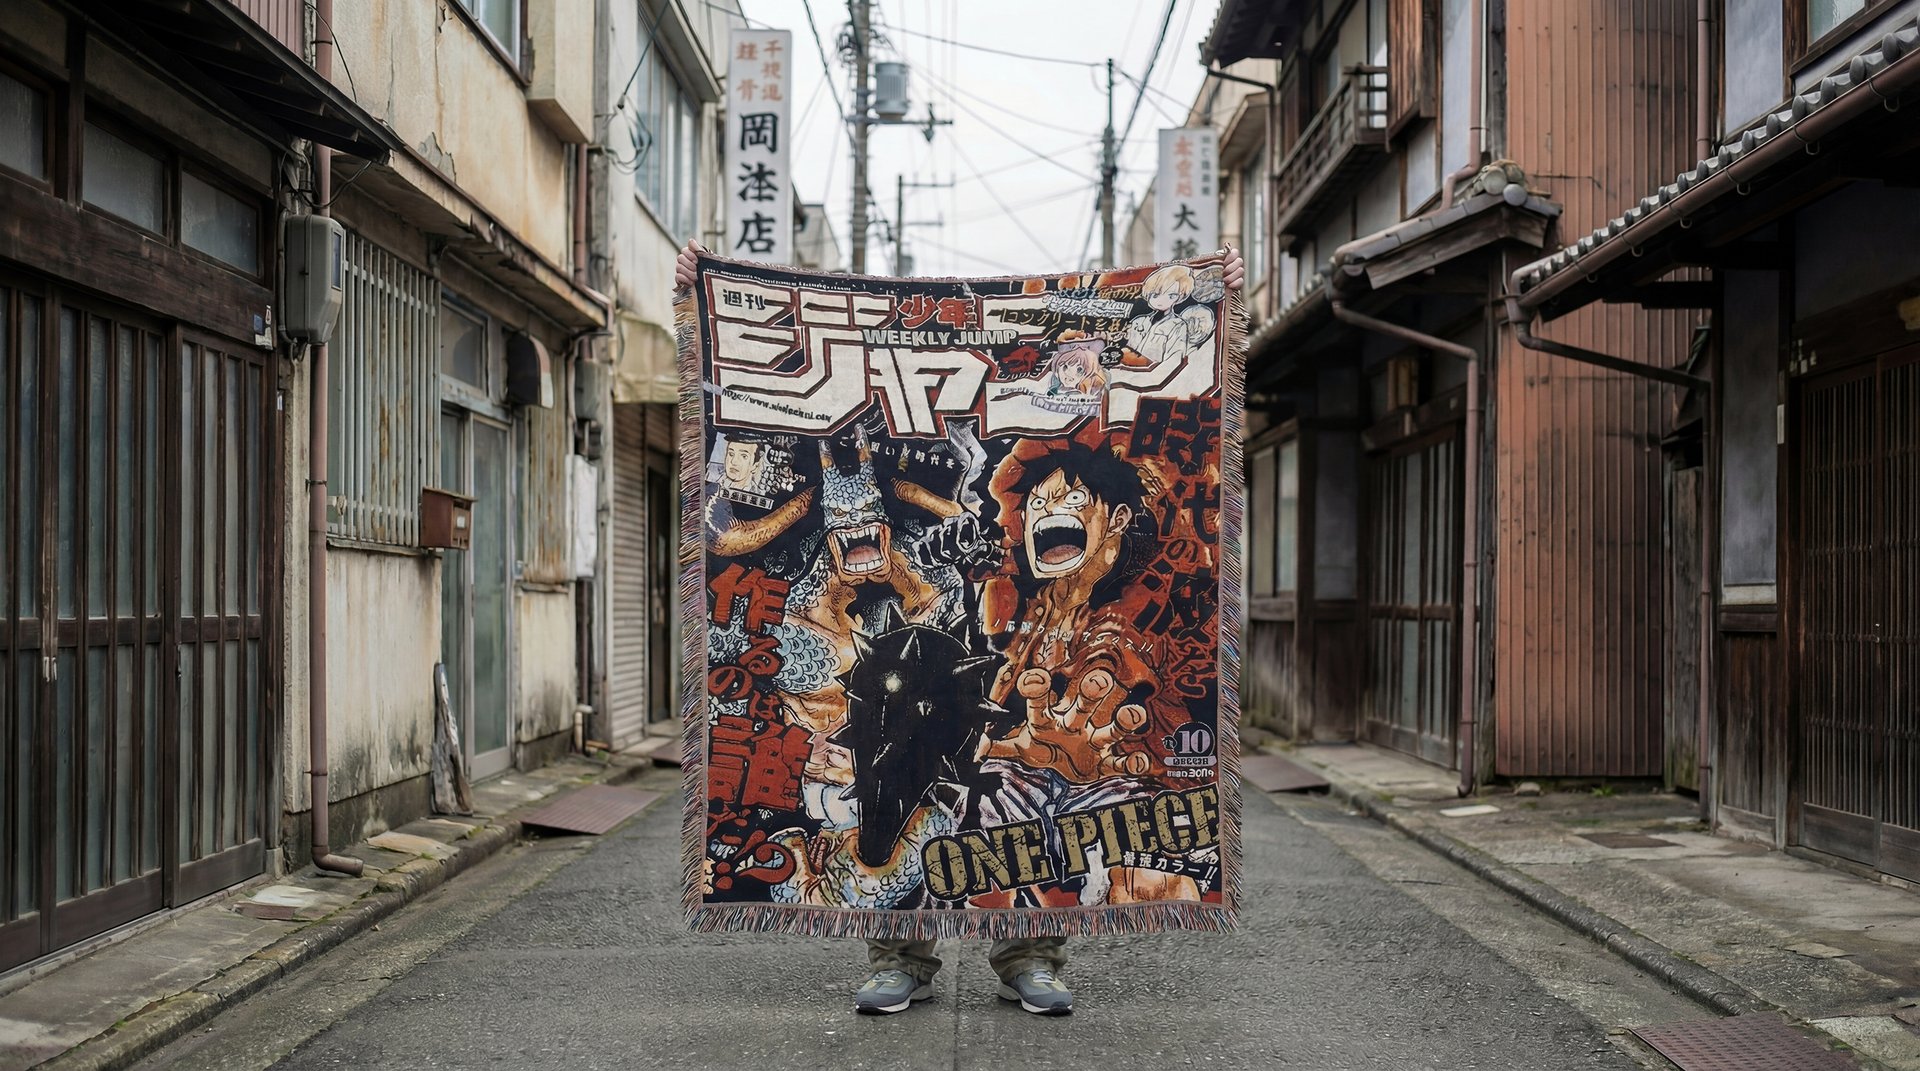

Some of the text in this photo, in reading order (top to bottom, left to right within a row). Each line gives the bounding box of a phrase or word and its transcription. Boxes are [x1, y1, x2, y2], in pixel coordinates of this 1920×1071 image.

[722, 288, 766, 311] 週刊
[898, 294, 977, 330] 少年
[863, 328, 1017, 347] WEEKLY JUMP
[1178, 729, 1211, 754] 10
[924, 788, 1219, 898] ONE PIECE
